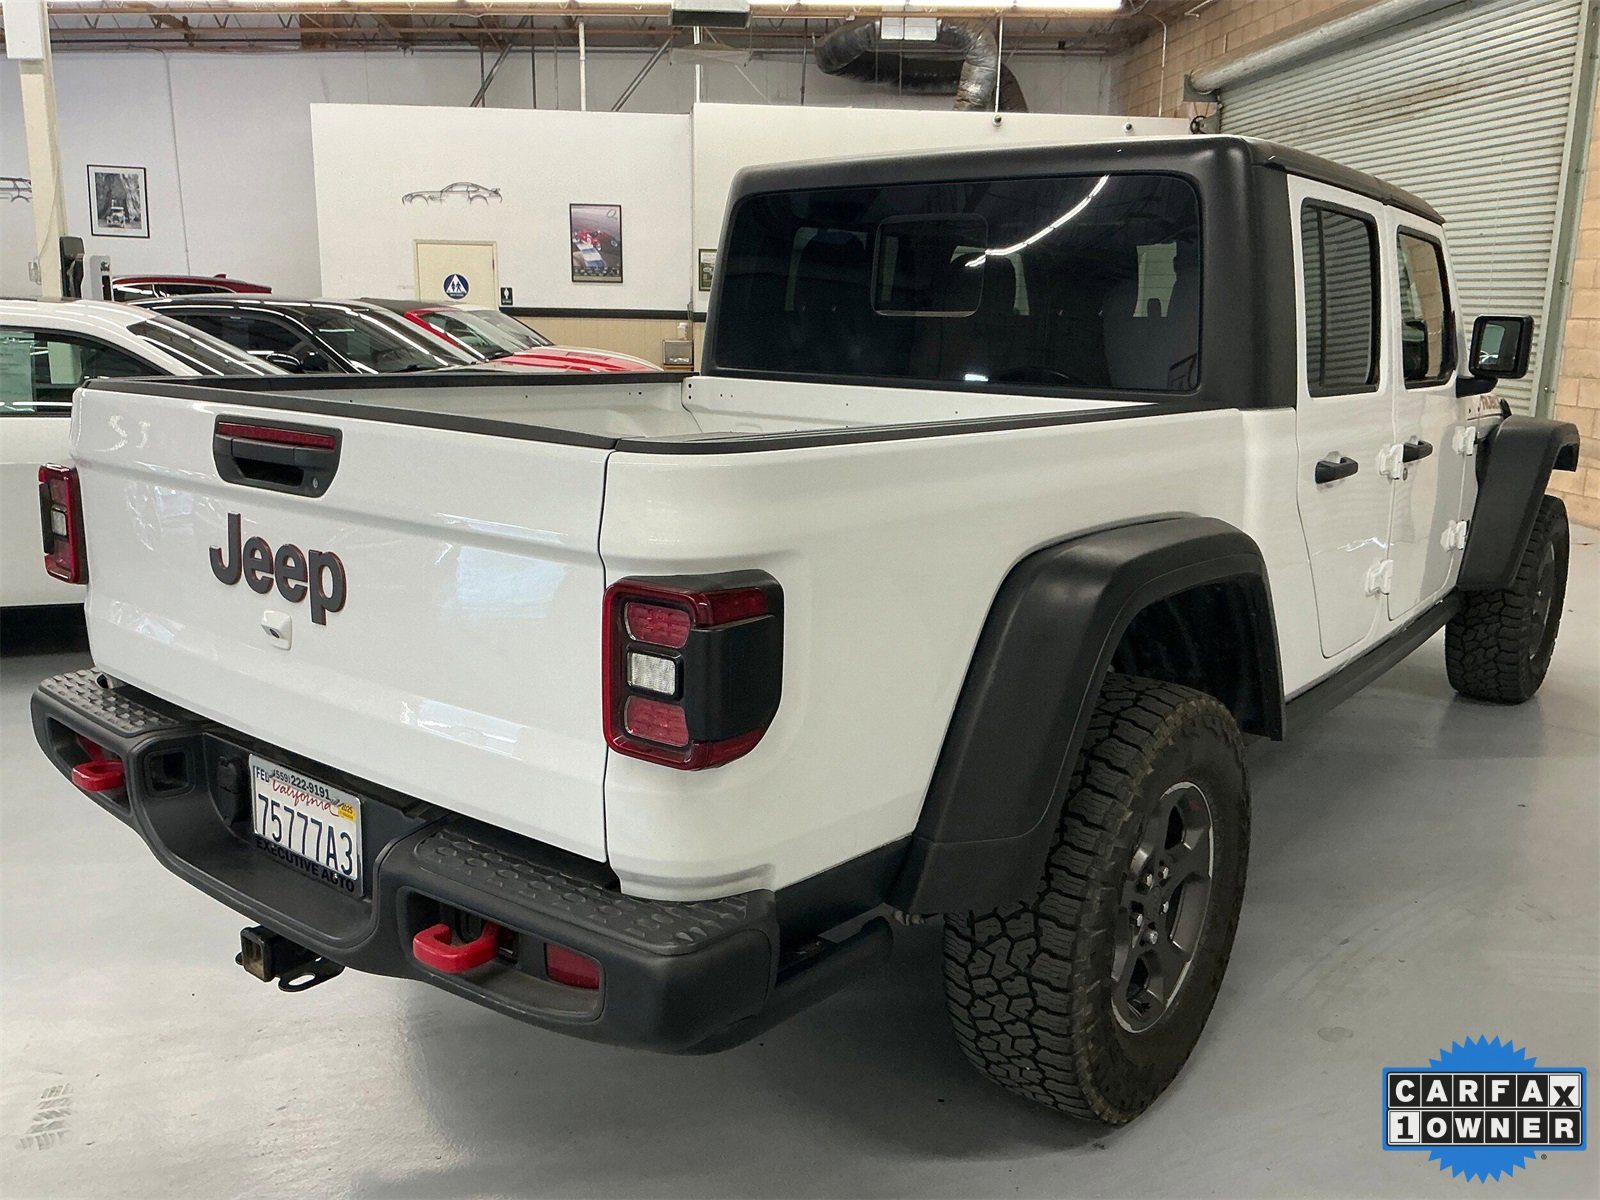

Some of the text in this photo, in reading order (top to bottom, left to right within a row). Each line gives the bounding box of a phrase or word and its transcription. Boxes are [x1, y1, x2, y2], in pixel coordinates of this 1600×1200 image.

[209, 511, 347, 626] Jeep
[291, 775, 330, 801] 222-9191
[256, 838, 355, 893] EXECUTIVE AUTO
[258, 793, 353, 876] 75777A3
